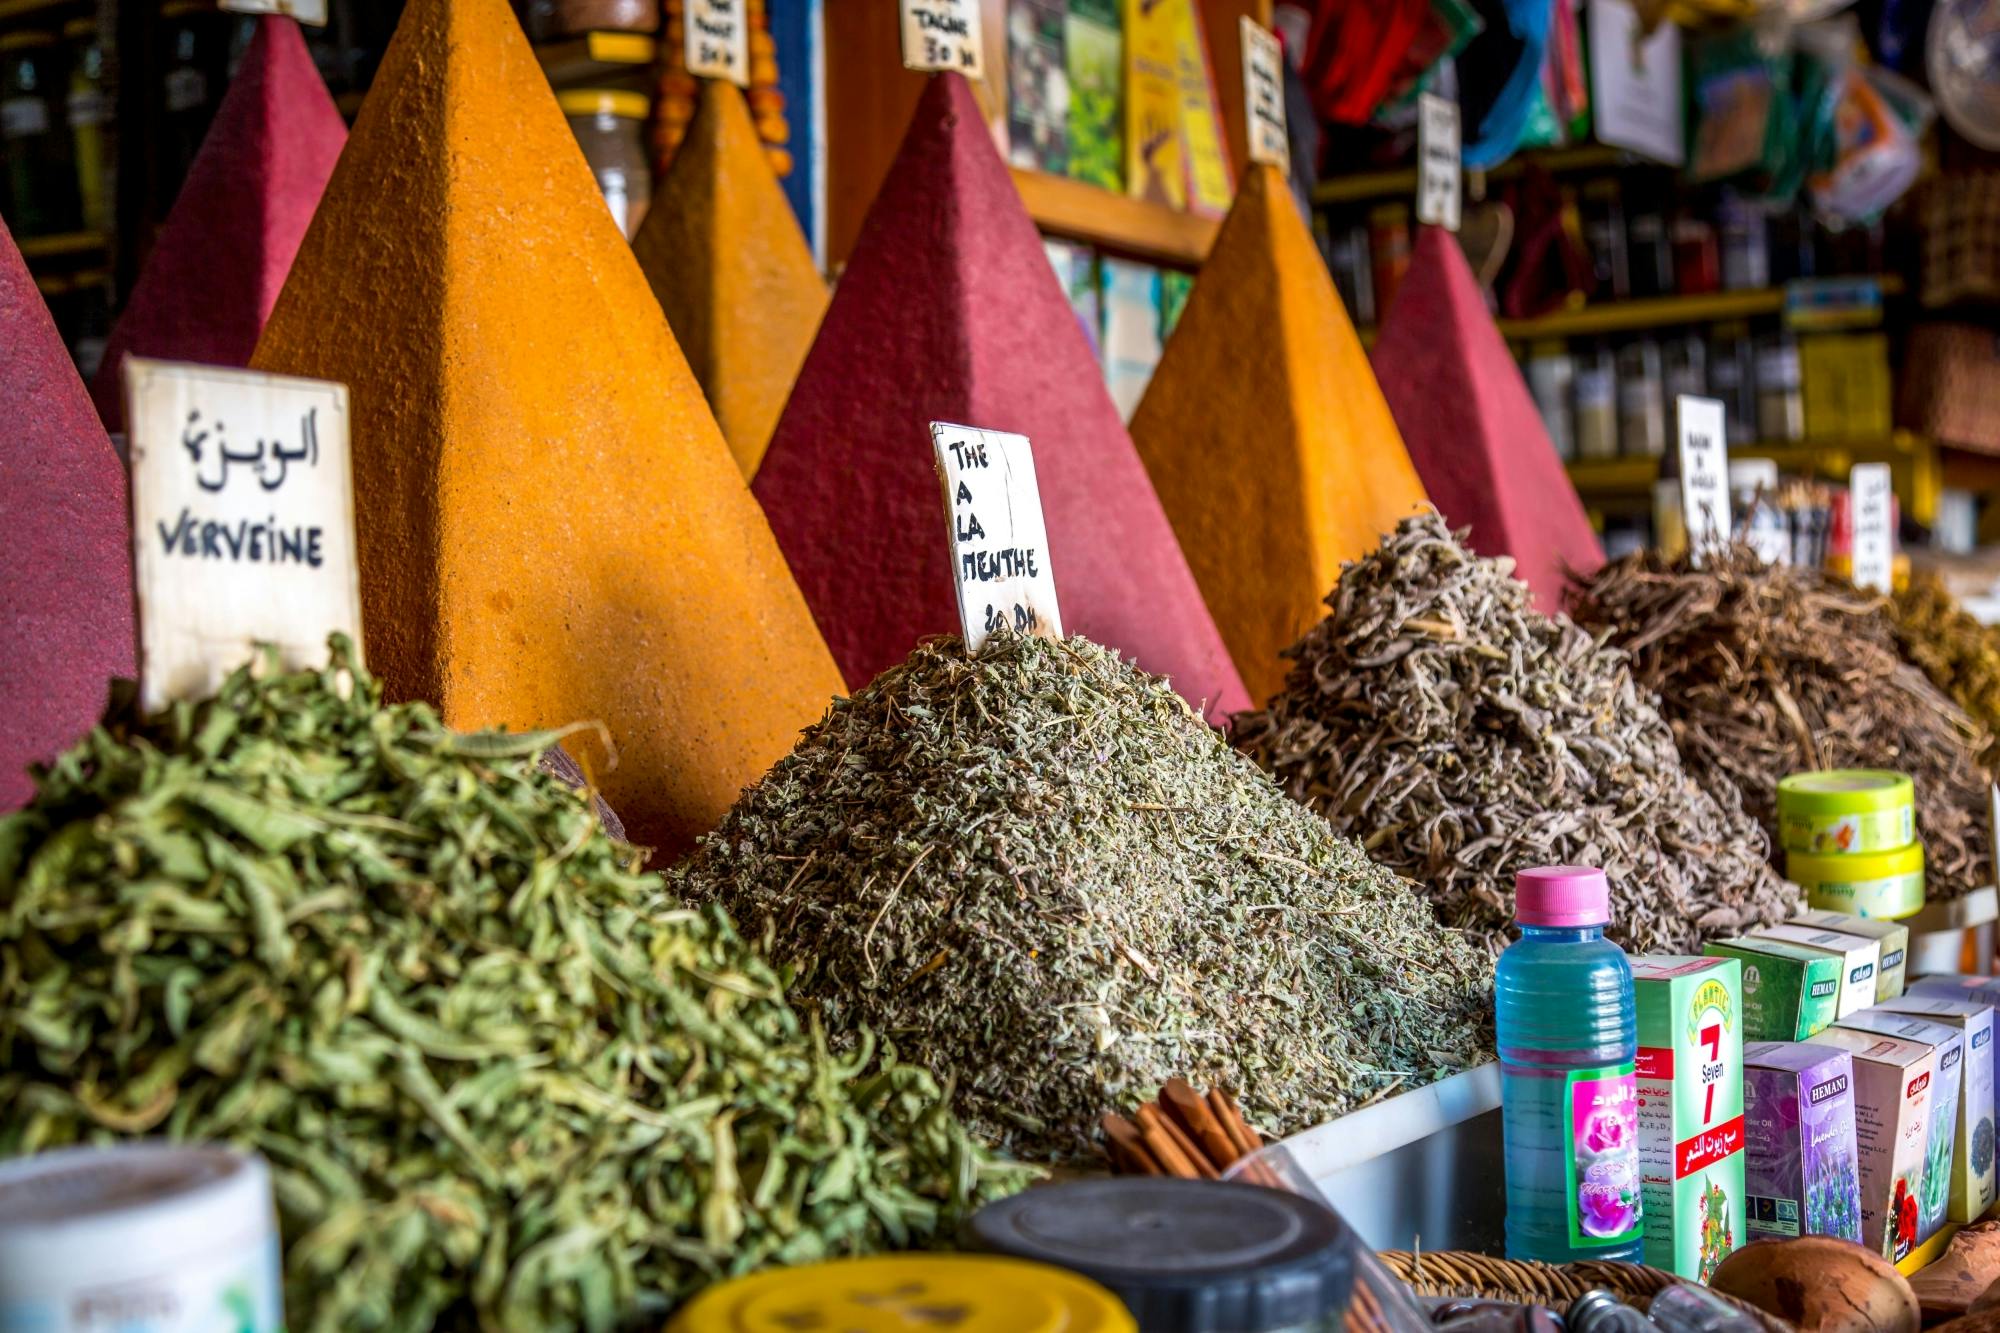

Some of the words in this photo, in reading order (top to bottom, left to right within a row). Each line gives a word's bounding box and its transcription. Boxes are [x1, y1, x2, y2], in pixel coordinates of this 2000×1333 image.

[949, 440, 989, 470] THE
[956, 480, 973, 506] A
[957, 512, 986, 542] LA
[962, 547, 1039, 583] MENTHE
[1013, 602, 1038, 632] DH
[1812, 982, 1836, 997] HEMANI
[1702, 1062, 1724, 1083] Seven
[1811, 1076, 1846, 1102] HEMANI
[1708, 1132, 1723, 1158] زيوت
[1723, 1129, 1737, 1155] سبع
